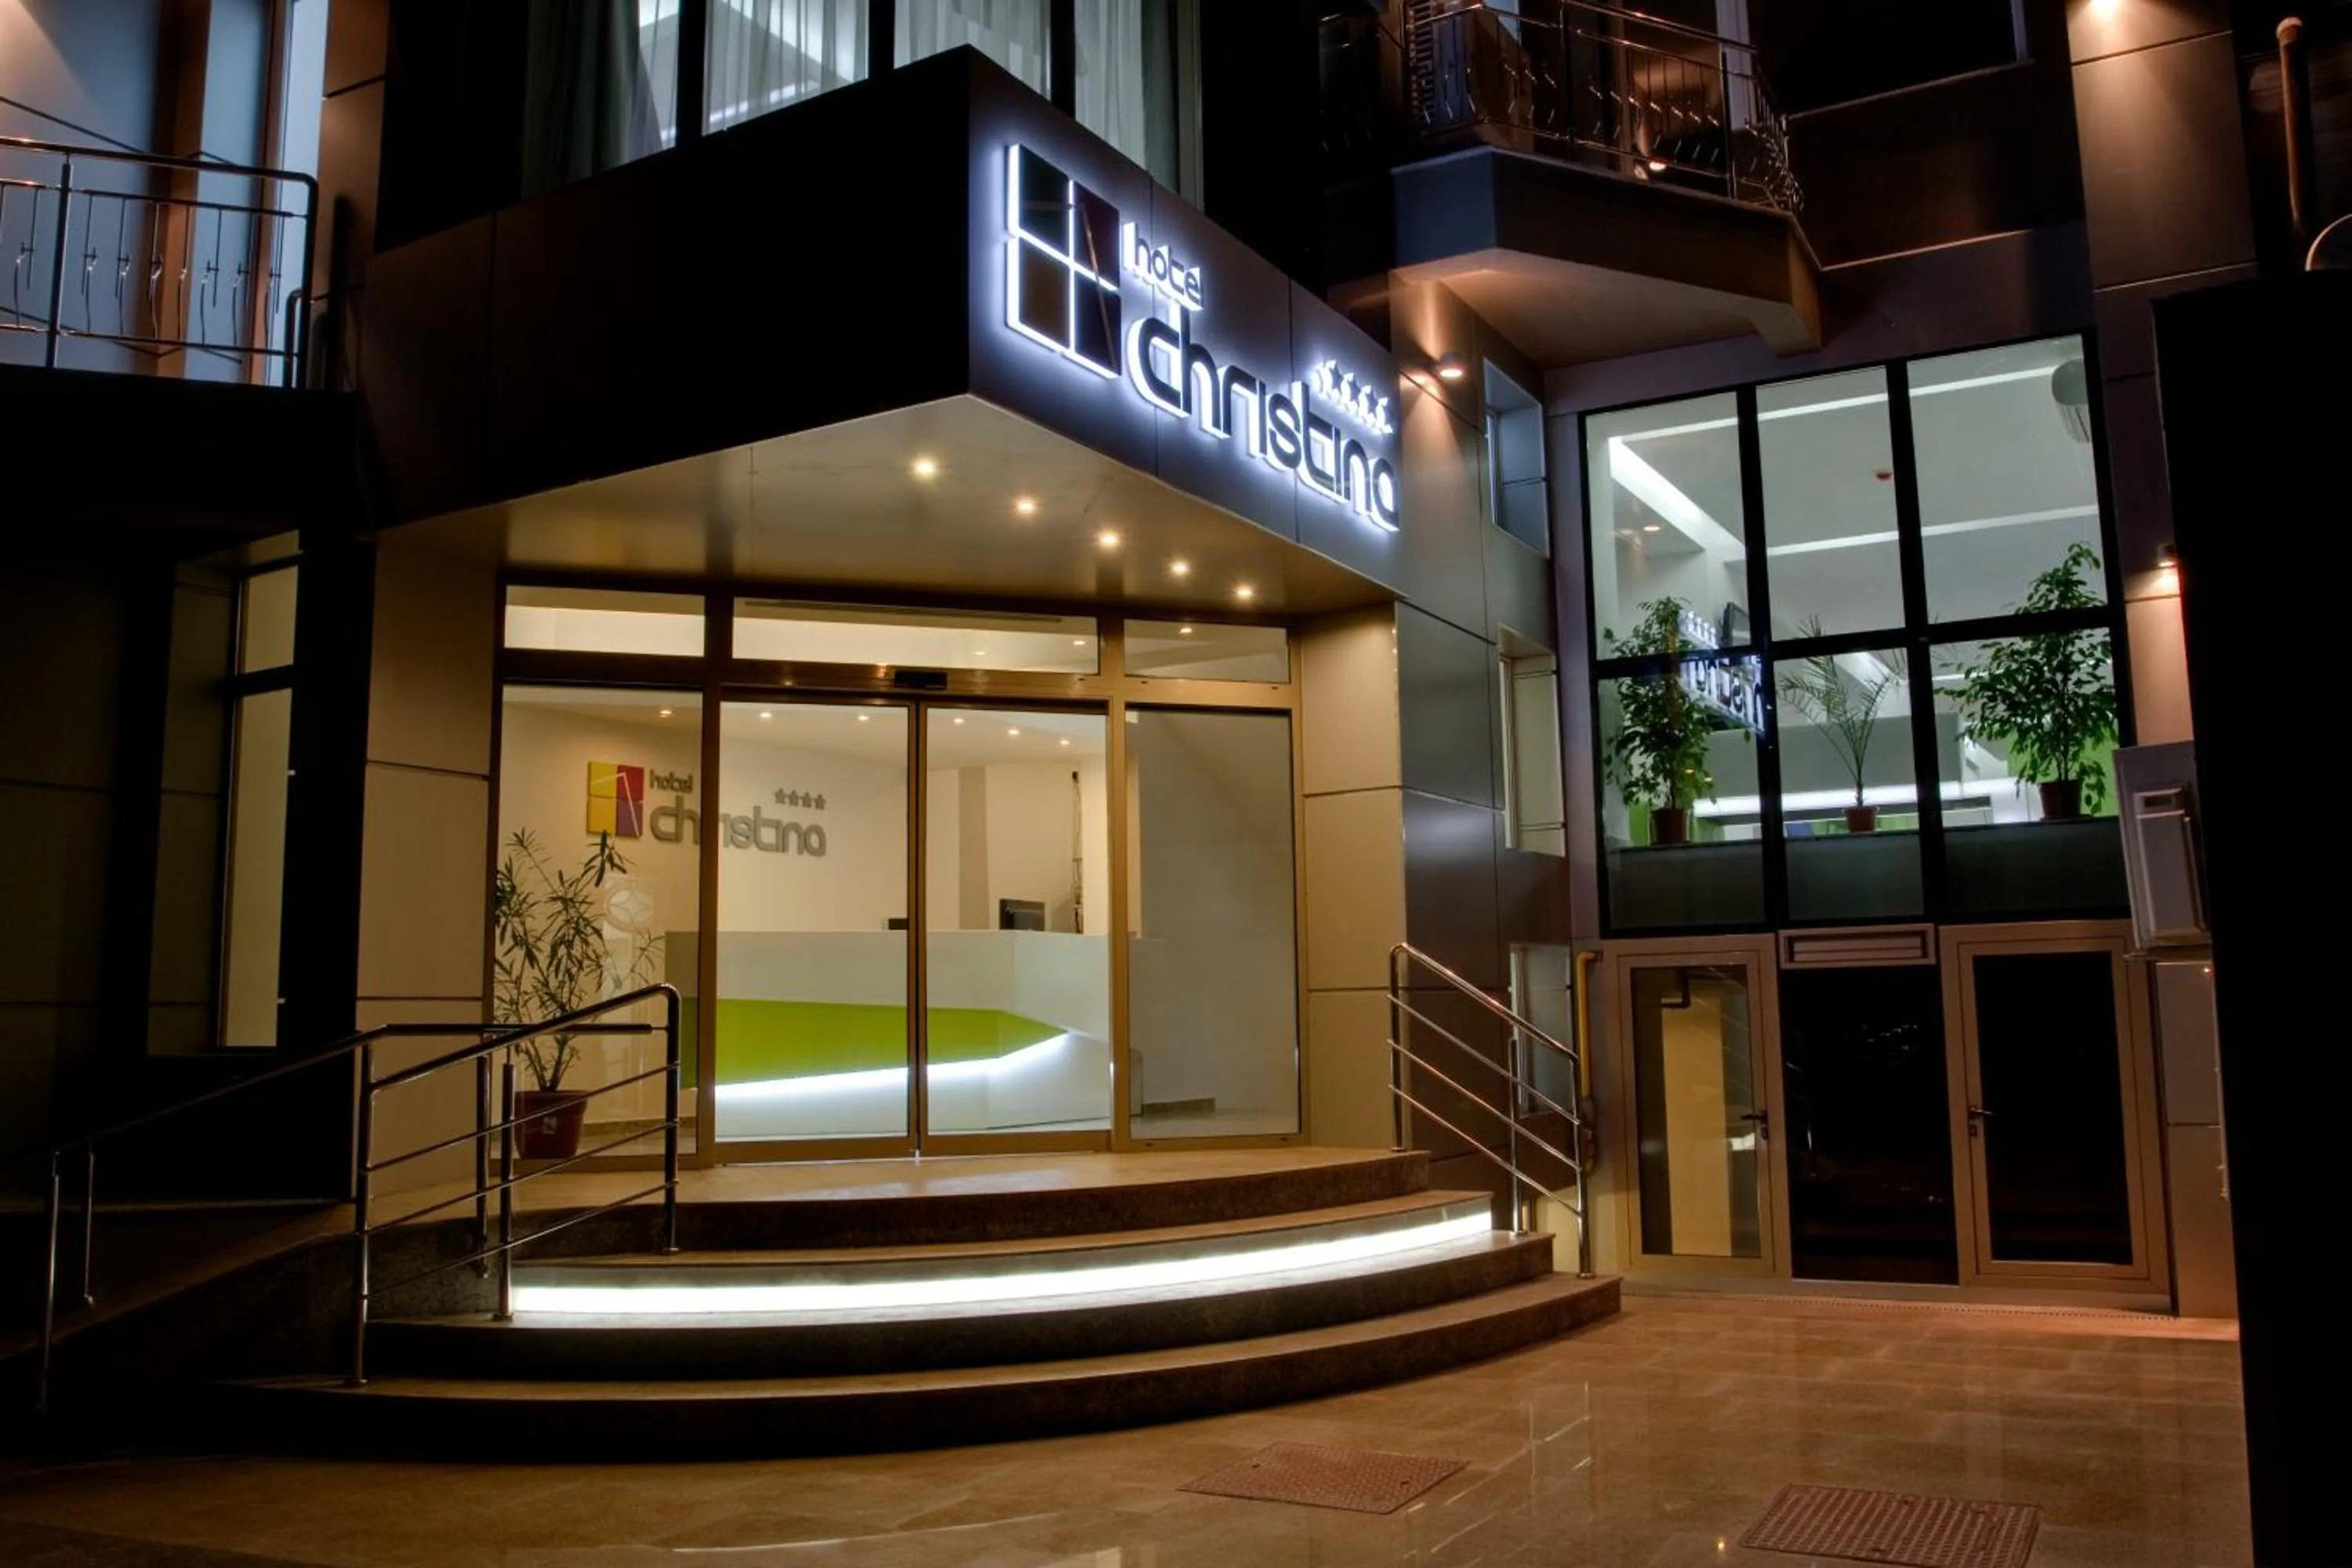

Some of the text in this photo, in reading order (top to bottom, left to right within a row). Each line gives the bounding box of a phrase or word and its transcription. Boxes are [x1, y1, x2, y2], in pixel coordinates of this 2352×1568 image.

[1123, 222, 1205, 311] hotel
[1127, 298, 1399, 532] christina
[649, 769, 693, 793] hotel
